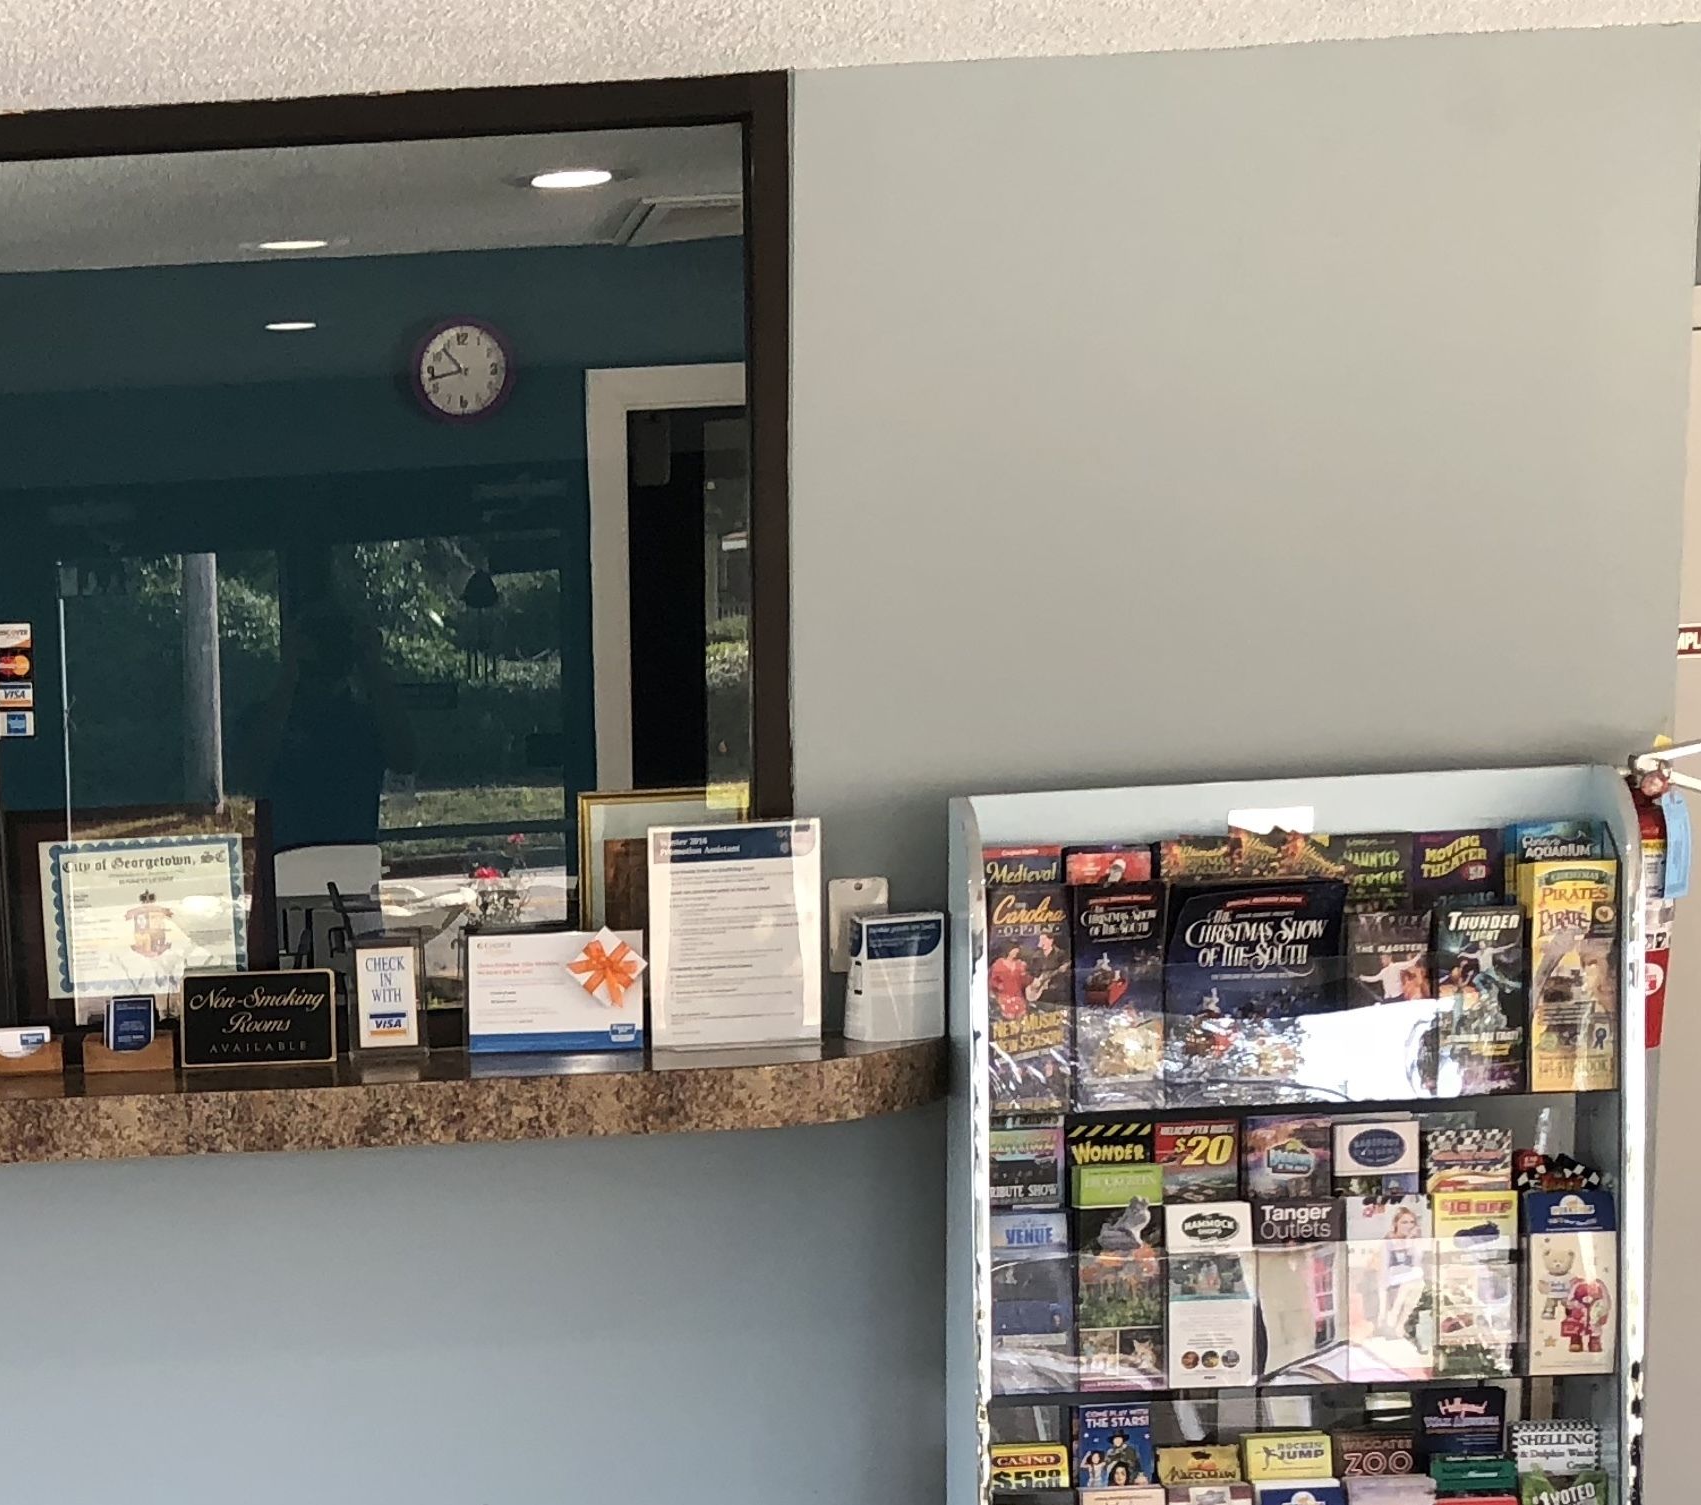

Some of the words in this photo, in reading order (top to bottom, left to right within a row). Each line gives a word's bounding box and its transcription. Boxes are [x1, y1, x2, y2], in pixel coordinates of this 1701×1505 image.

[4, 690, 25, 699] VISA
[1425, 834, 1481, 863] MOVING
[1524, 843, 1592, 861] AQUARIUM
[62, 860, 90, 874] City
[95, 858, 106, 871] of
[111, 854, 196, 870] Georgetown,
[1420, 847, 1488, 879] THEATER
[986, 861, 1058, 886] Medieval
[1540, 886, 1609, 903] PIRATES
[992, 894, 1067, 925] Carolina
[1447, 910, 1521, 932] THUNDER
[1537, 907, 1592, 937] PIRATE
[1185, 918, 1275, 949] CHRISTMAS
[1273, 916, 1329, 946] SHOW
[1470, 930, 1501, 942] LIGHT
[365, 956, 405, 972] CHECK
[1198, 946, 1221, 968] OF
[1221, 941, 1252, 968] THE
[1250, 941, 1310, 972] SOUTH
[380, 972, 392, 987] IN
[189, 986, 325, 1013] Non-Smoking
[372, 988, 402, 1003] WITH
[222, 1011, 292, 1034] Rooms
[375, 1019, 402, 1029] VISA
[209, 1041, 308, 1054] AVAILABLE
[1071, 1140, 1145, 1165] WONDER
[1174, 1134, 1235, 1166] $20
[989, 1184, 1025, 1198] RIBUTE
[1028, 1184, 1058, 1197] SHOW
[1261, 1205, 1332, 1224] Tanger
[1475, 1201, 1513, 1214] OFF
[1183, 1219, 1236, 1231] HAMMOCK
[1260, 1221, 1332, 1240] Outlets
[1005, 1227, 1054, 1245] VENUE
[1084, 1418, 1109, 1429] THE
[1111, 1416, 1150, 1428] STARS!
[1085, 1410, 1107, 1419] COME
[1519, 1433, 1595, 1446] SHELLING
[996, 1455, 1057, 1466] CASINO
[1277, 1450, 1325, 1461] JUMP
[1343, 1450, 1414, 1477] ZOO
